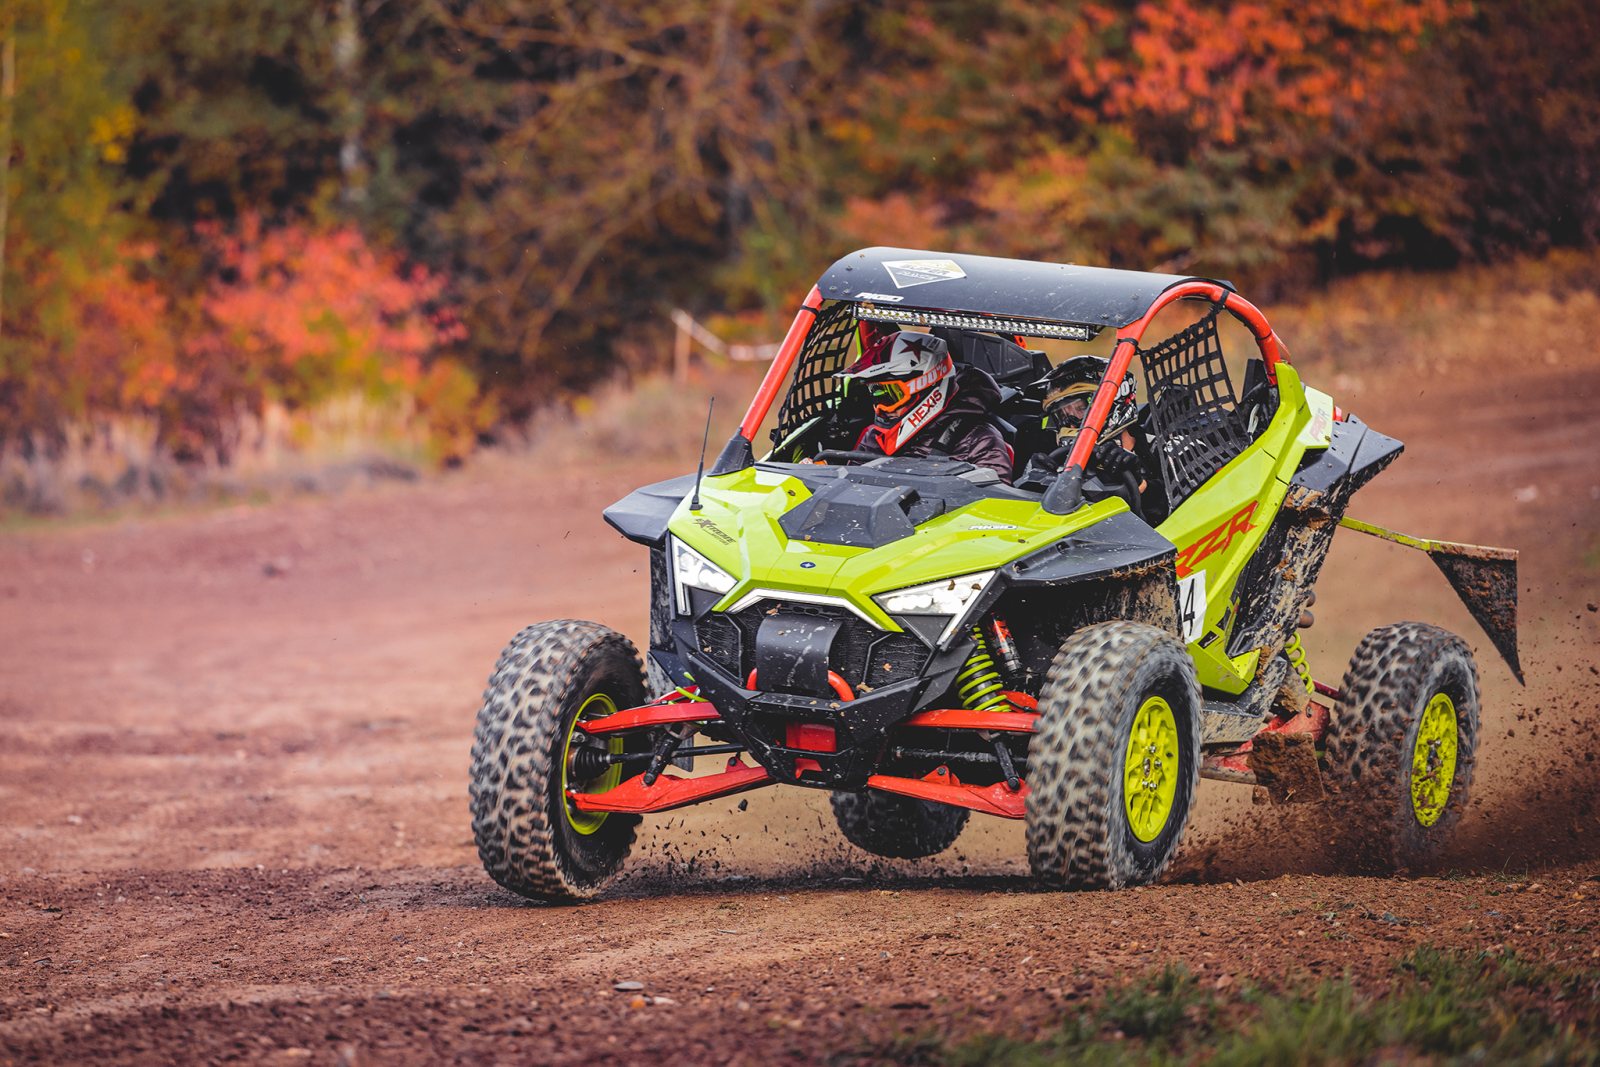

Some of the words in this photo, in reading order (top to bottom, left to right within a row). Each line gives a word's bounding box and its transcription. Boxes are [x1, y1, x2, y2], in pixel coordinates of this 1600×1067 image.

[907, 364, 947, 395] 100%
[907, 390, 942, 428] HEXIS
[1175, 500, 1259, 578] RZR
[1183, 577, 1196, 637] 4
